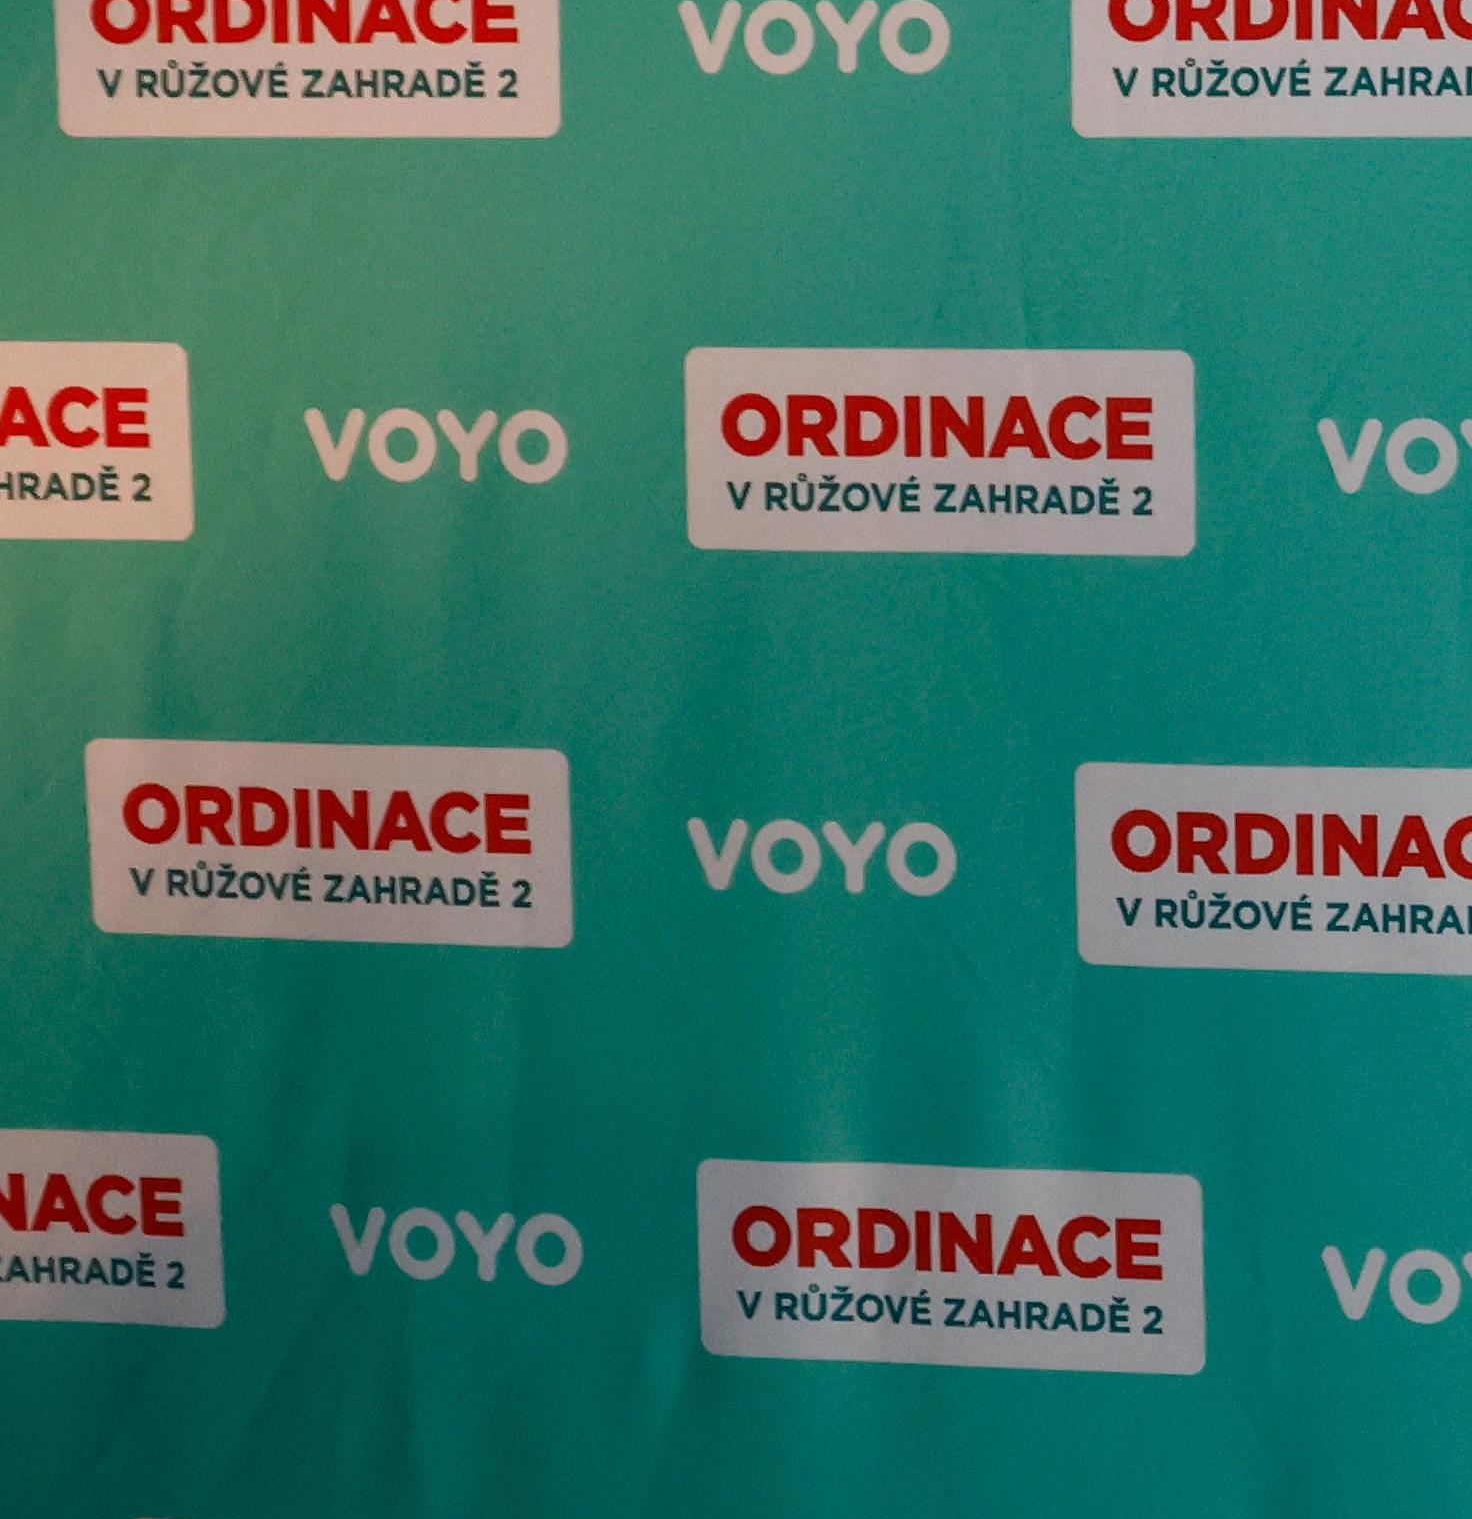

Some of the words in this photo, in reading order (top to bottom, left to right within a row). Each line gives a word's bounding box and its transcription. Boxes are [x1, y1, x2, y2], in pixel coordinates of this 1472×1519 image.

[97, 68, 123, 99] V
[135, 58, 289, 99] RŮŽOVÉ
[301, 60, 486, 99] ZAHRADĚ
[498, 67, 519, 99] 2
[1112, 65, 1139, 98] V
[1151, 56, 1312, 99] RŮŽOVÉ
[303, 406, 570, 485] VOYO
[722, 393, 1153, 459] ORDINACE
[123, 783, 531, 854] ORDINACE
[129, 866, 155, 897] V
[166, 858, 313, 903] RŮŽOVÉ
[323, 870, 501, 909] ZAHRADĚ
[511, 878, 533, 910] 2
[687, 817, 958, 897] VOYO
[1115, 896, 1143, 927] V
[1154, 888, 1314, 932] RŮŽOVÉ
[330, 1204, 584, 1286] VOYO
[733, 1206, 1162, 1280] ORDINACE
